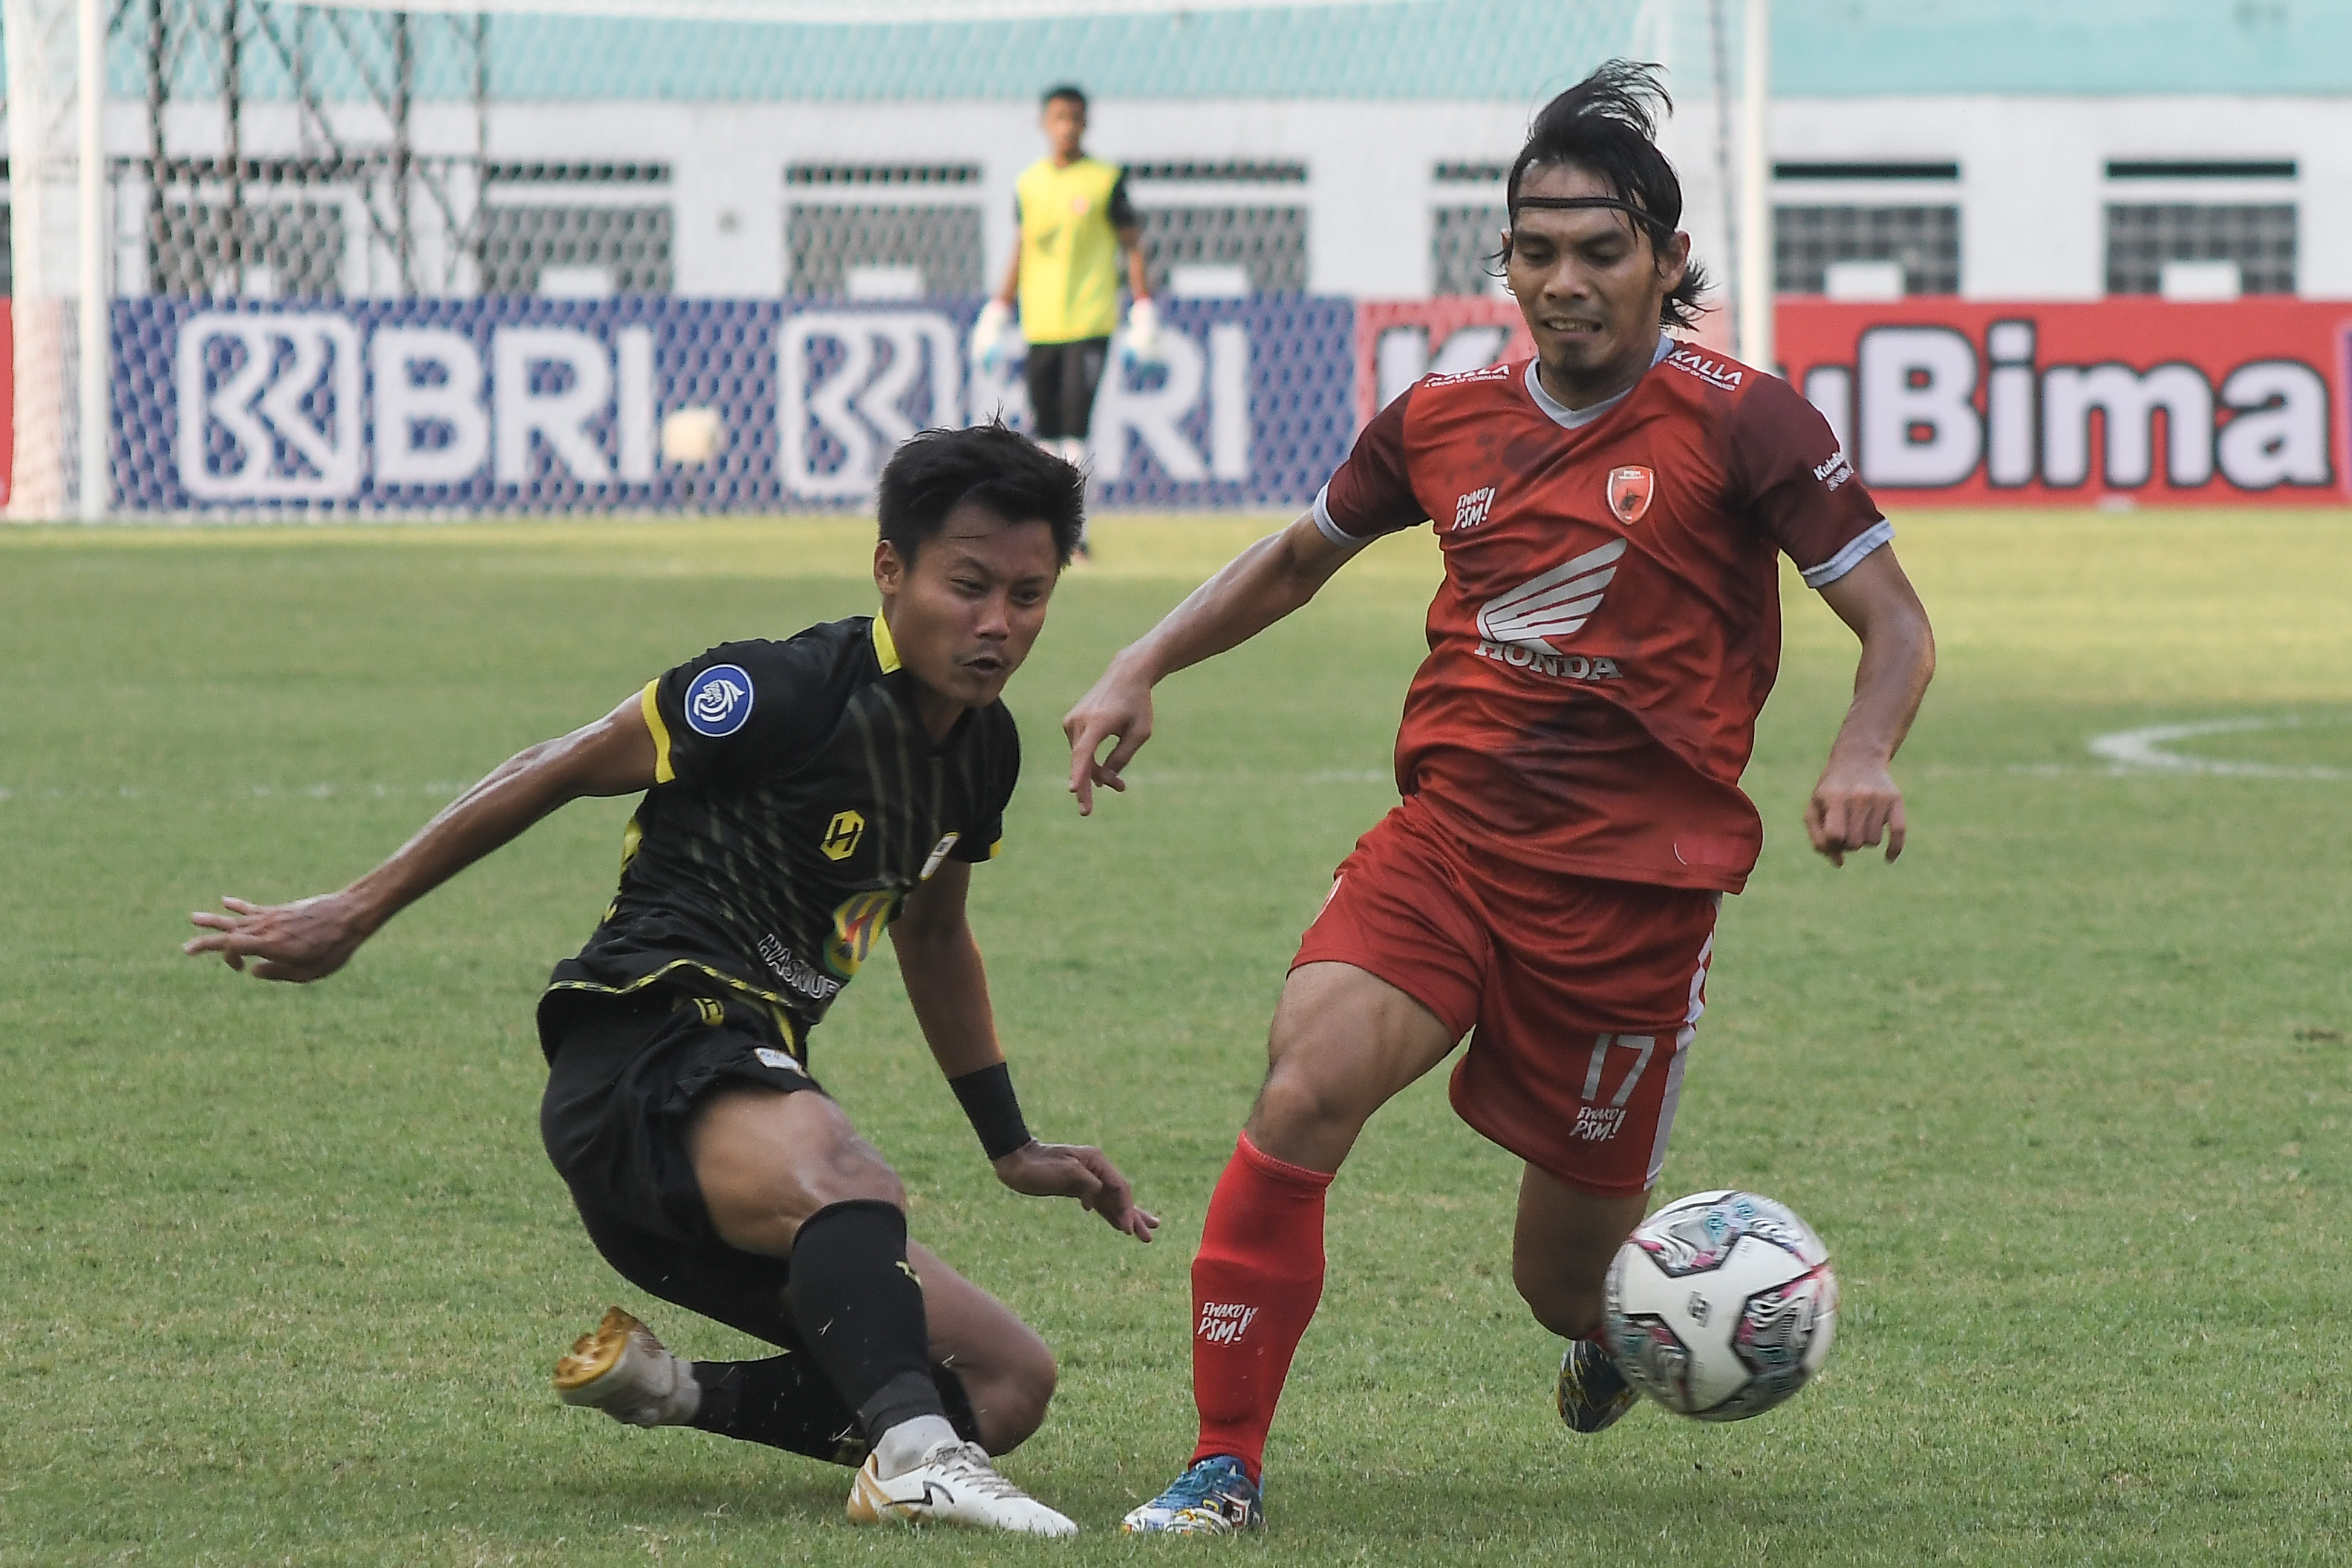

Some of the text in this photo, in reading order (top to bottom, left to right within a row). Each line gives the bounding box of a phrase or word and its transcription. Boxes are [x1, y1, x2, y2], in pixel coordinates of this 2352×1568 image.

[1667, 348, 1744, 386] KALLA
[373, 325, 654, 484] BRI
[1473, 640, 1623, 681] HONDA
[1580, 1033, 1656, 1107] 17
[1202, 1301, 1245, 1319] EWAKO
